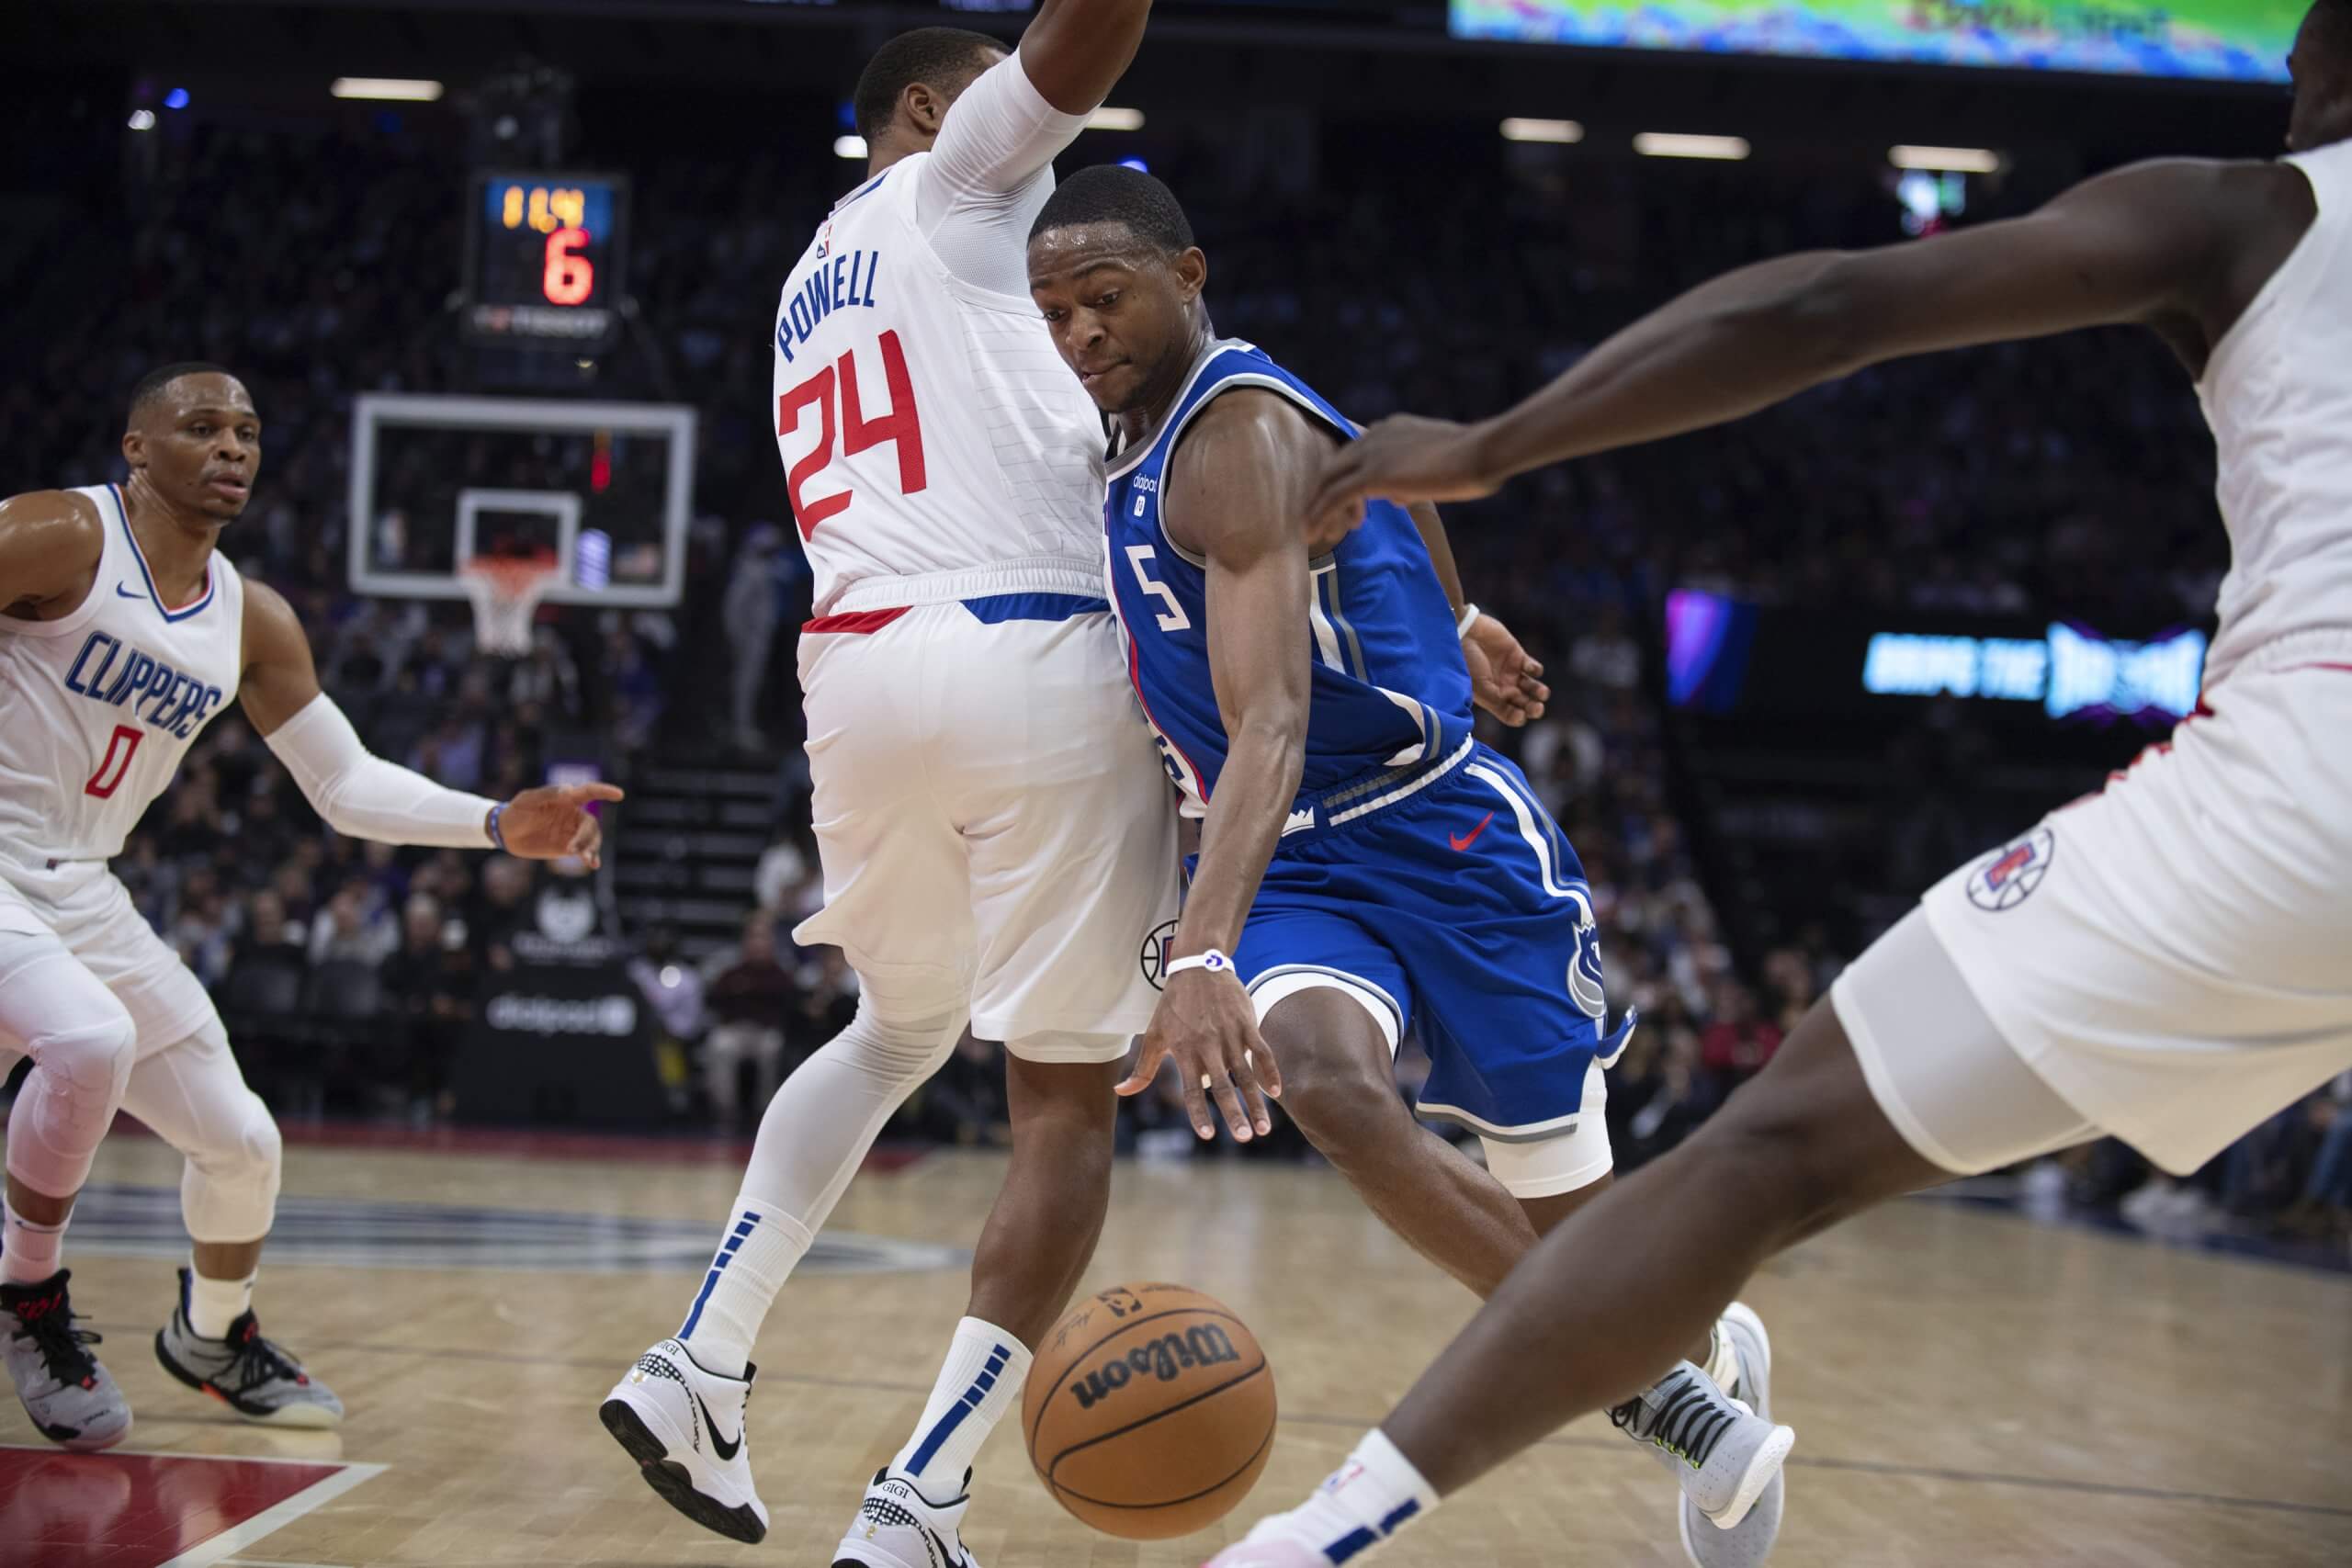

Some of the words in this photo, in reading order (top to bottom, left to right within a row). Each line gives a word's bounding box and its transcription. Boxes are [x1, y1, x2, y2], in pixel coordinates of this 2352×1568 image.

[543, 227, 594, 306] 6
[777, 250, 879, 364] POWELL
[778, 329, 927, 544] 24
[1125, 545, 1191, 632] 5
[65, 629, 222, 740] CLIPPERS
[85, 724, 145, 799] 0
[1070, 1323, 1241, 1409] Wilson
[882, 1483, 910, 1499] GIGI
